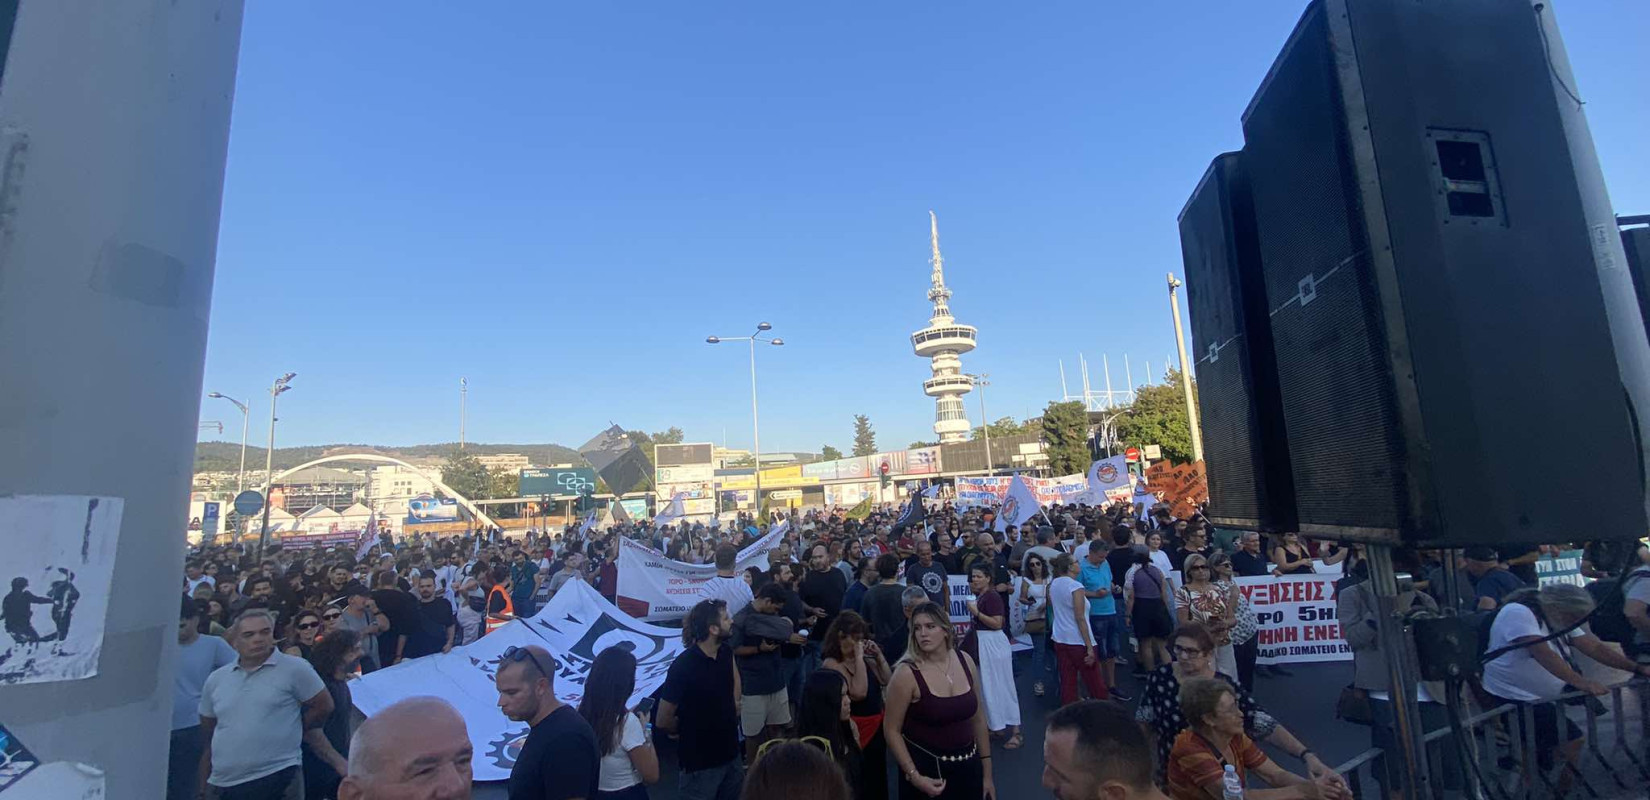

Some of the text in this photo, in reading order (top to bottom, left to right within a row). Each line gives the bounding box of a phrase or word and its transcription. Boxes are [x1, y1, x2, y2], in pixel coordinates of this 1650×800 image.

[207, 504, 217, 516] P
[1240, 581, 1338, 605] ΥΞΗΣΕΙΣ Σ
[1257, 606, 1337, 625] ΡΟ 5Η
[1258, 626, 1298, 645] ΗΝΗ
[1289, 644, 1337, 656] ΣΩΜΑΤΕΙΟ
